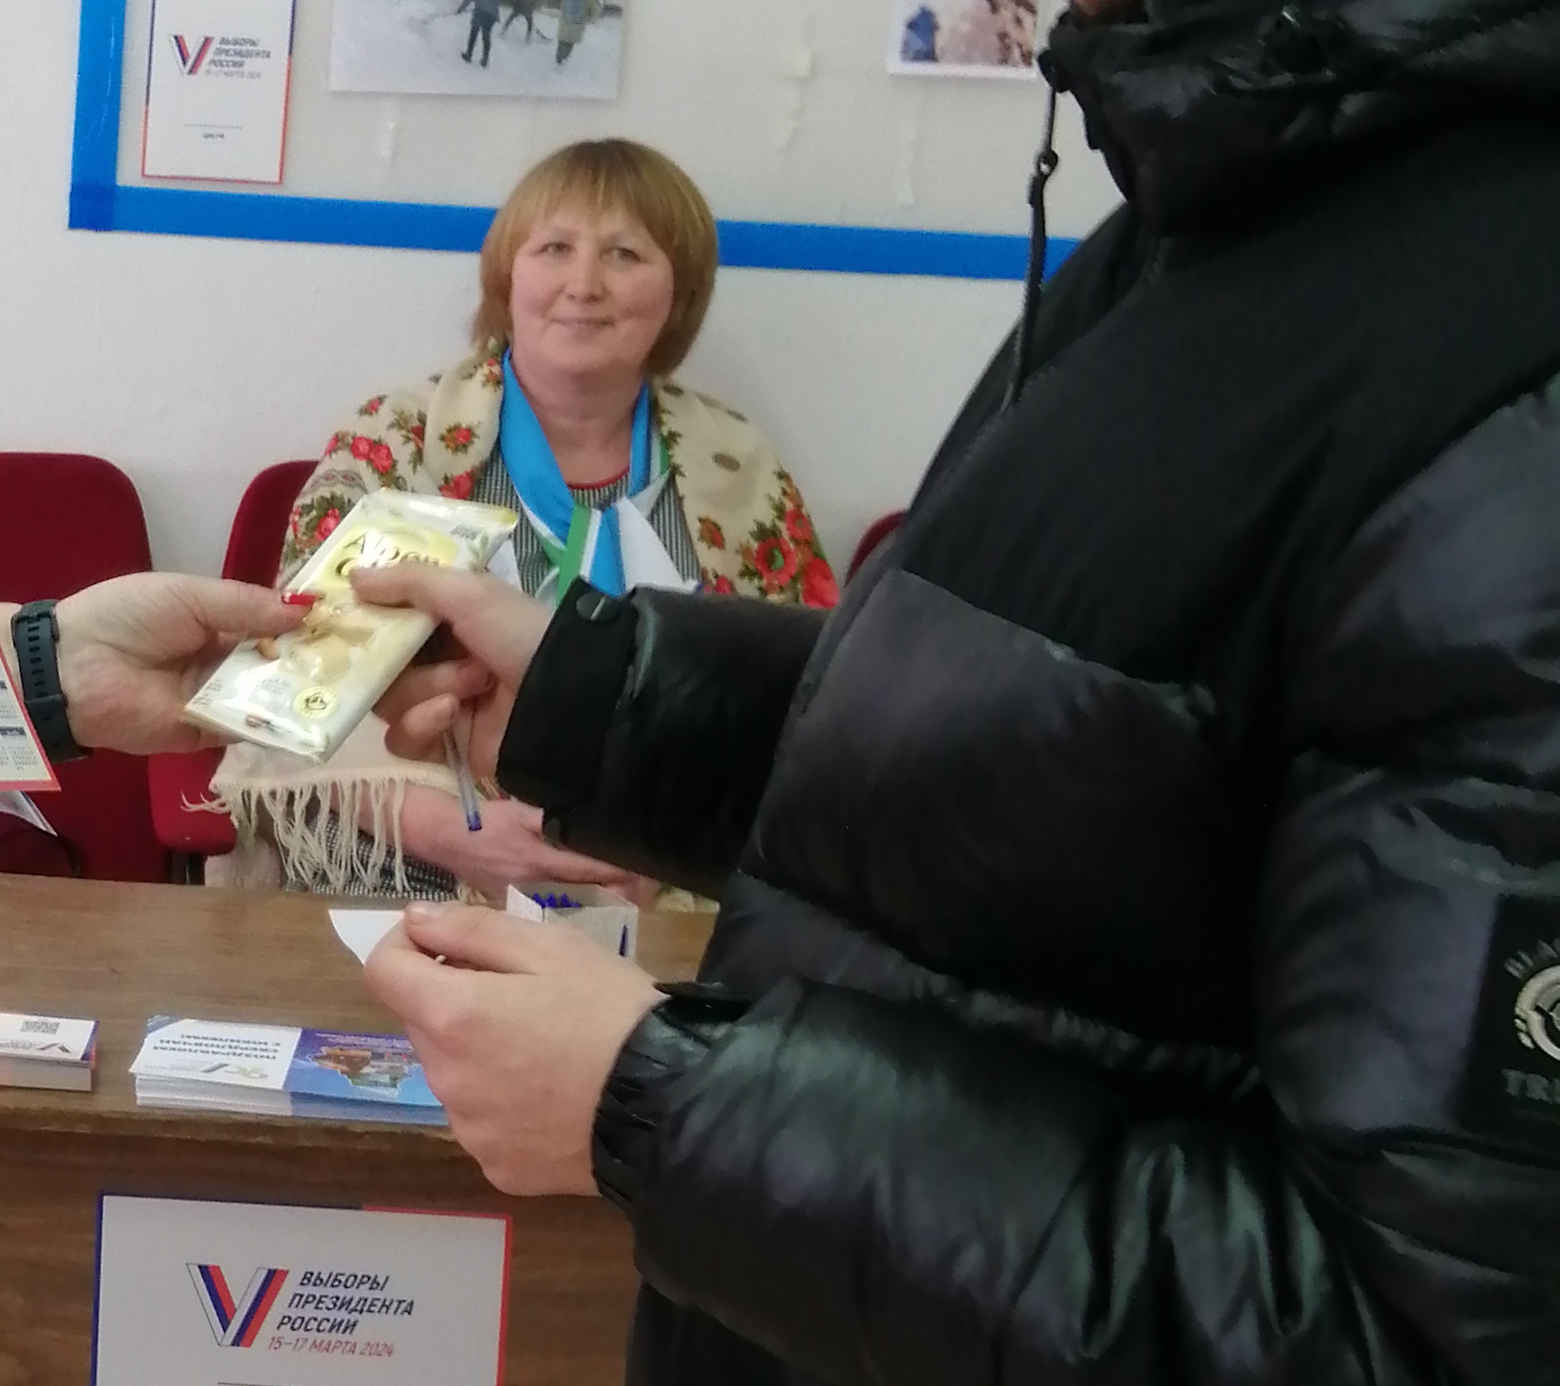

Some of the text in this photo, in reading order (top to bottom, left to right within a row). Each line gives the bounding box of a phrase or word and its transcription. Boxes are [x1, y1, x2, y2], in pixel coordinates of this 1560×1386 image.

[299, 1271, 390, 1291] ВЫБОРЫ
[287, 1293, 415, 1316] ПРЕЗИДЕНТА
[276, 1315, 359, 1335] РОССИИ
[309, 1338, 357, 1356] МАРТА
[359, 1341, 394, 1358] 2024
